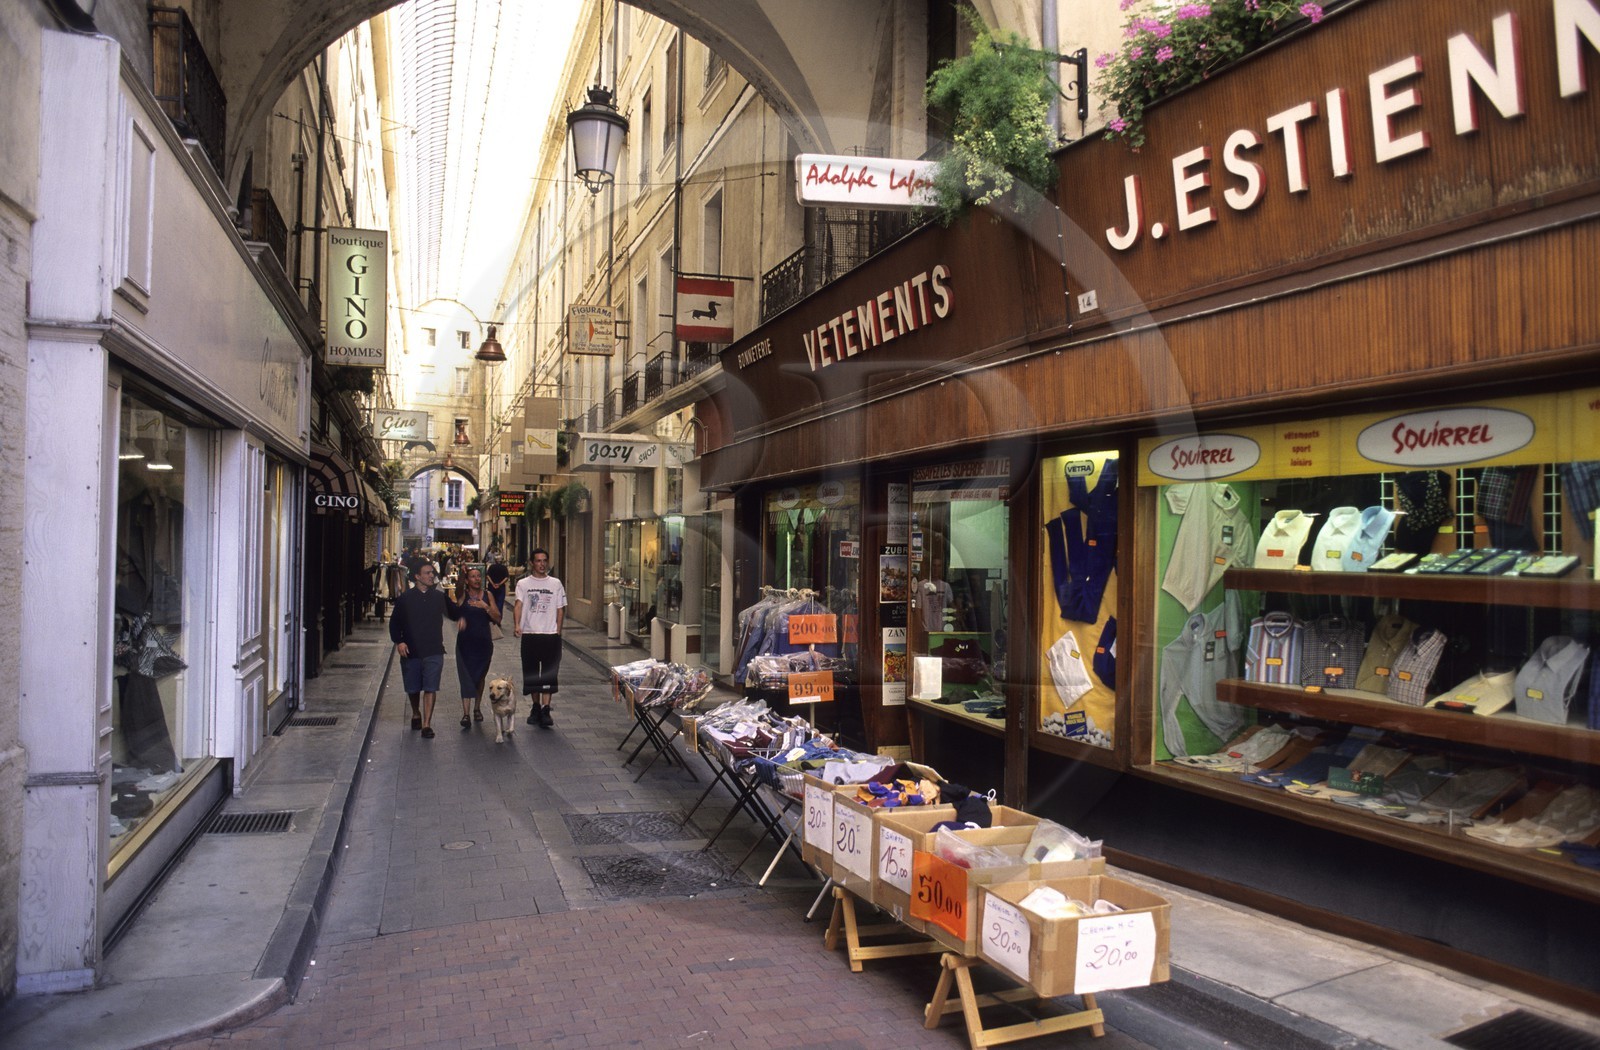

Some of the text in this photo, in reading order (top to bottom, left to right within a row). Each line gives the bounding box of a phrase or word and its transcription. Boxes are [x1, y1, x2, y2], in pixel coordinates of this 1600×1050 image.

[806, 163, 877, 193] Adolphe
[331, 235, 384, 249] boutique
[344, 254, 368, 339] GINO
[802, 264, 953, 372] VETEMENTS
[329, 345, 383, 358] HOMMES
[737, 337, 773, 370] BONNETERIE
[380, 415, 418, 437] Gino
[588, 442, 634, 463] JOSY
[638, 444, 657, 464] SHOP
[1292, 445, 1312, 454] sport
[1067, 465, 1092, 473] VETRA
[1290, 458, 1313, 467] loisirs
[315, 495, 359, 509] GINO
[988, 922, 1022, 955] 20,00
[1085, 944, 1138, 970] 20,00
